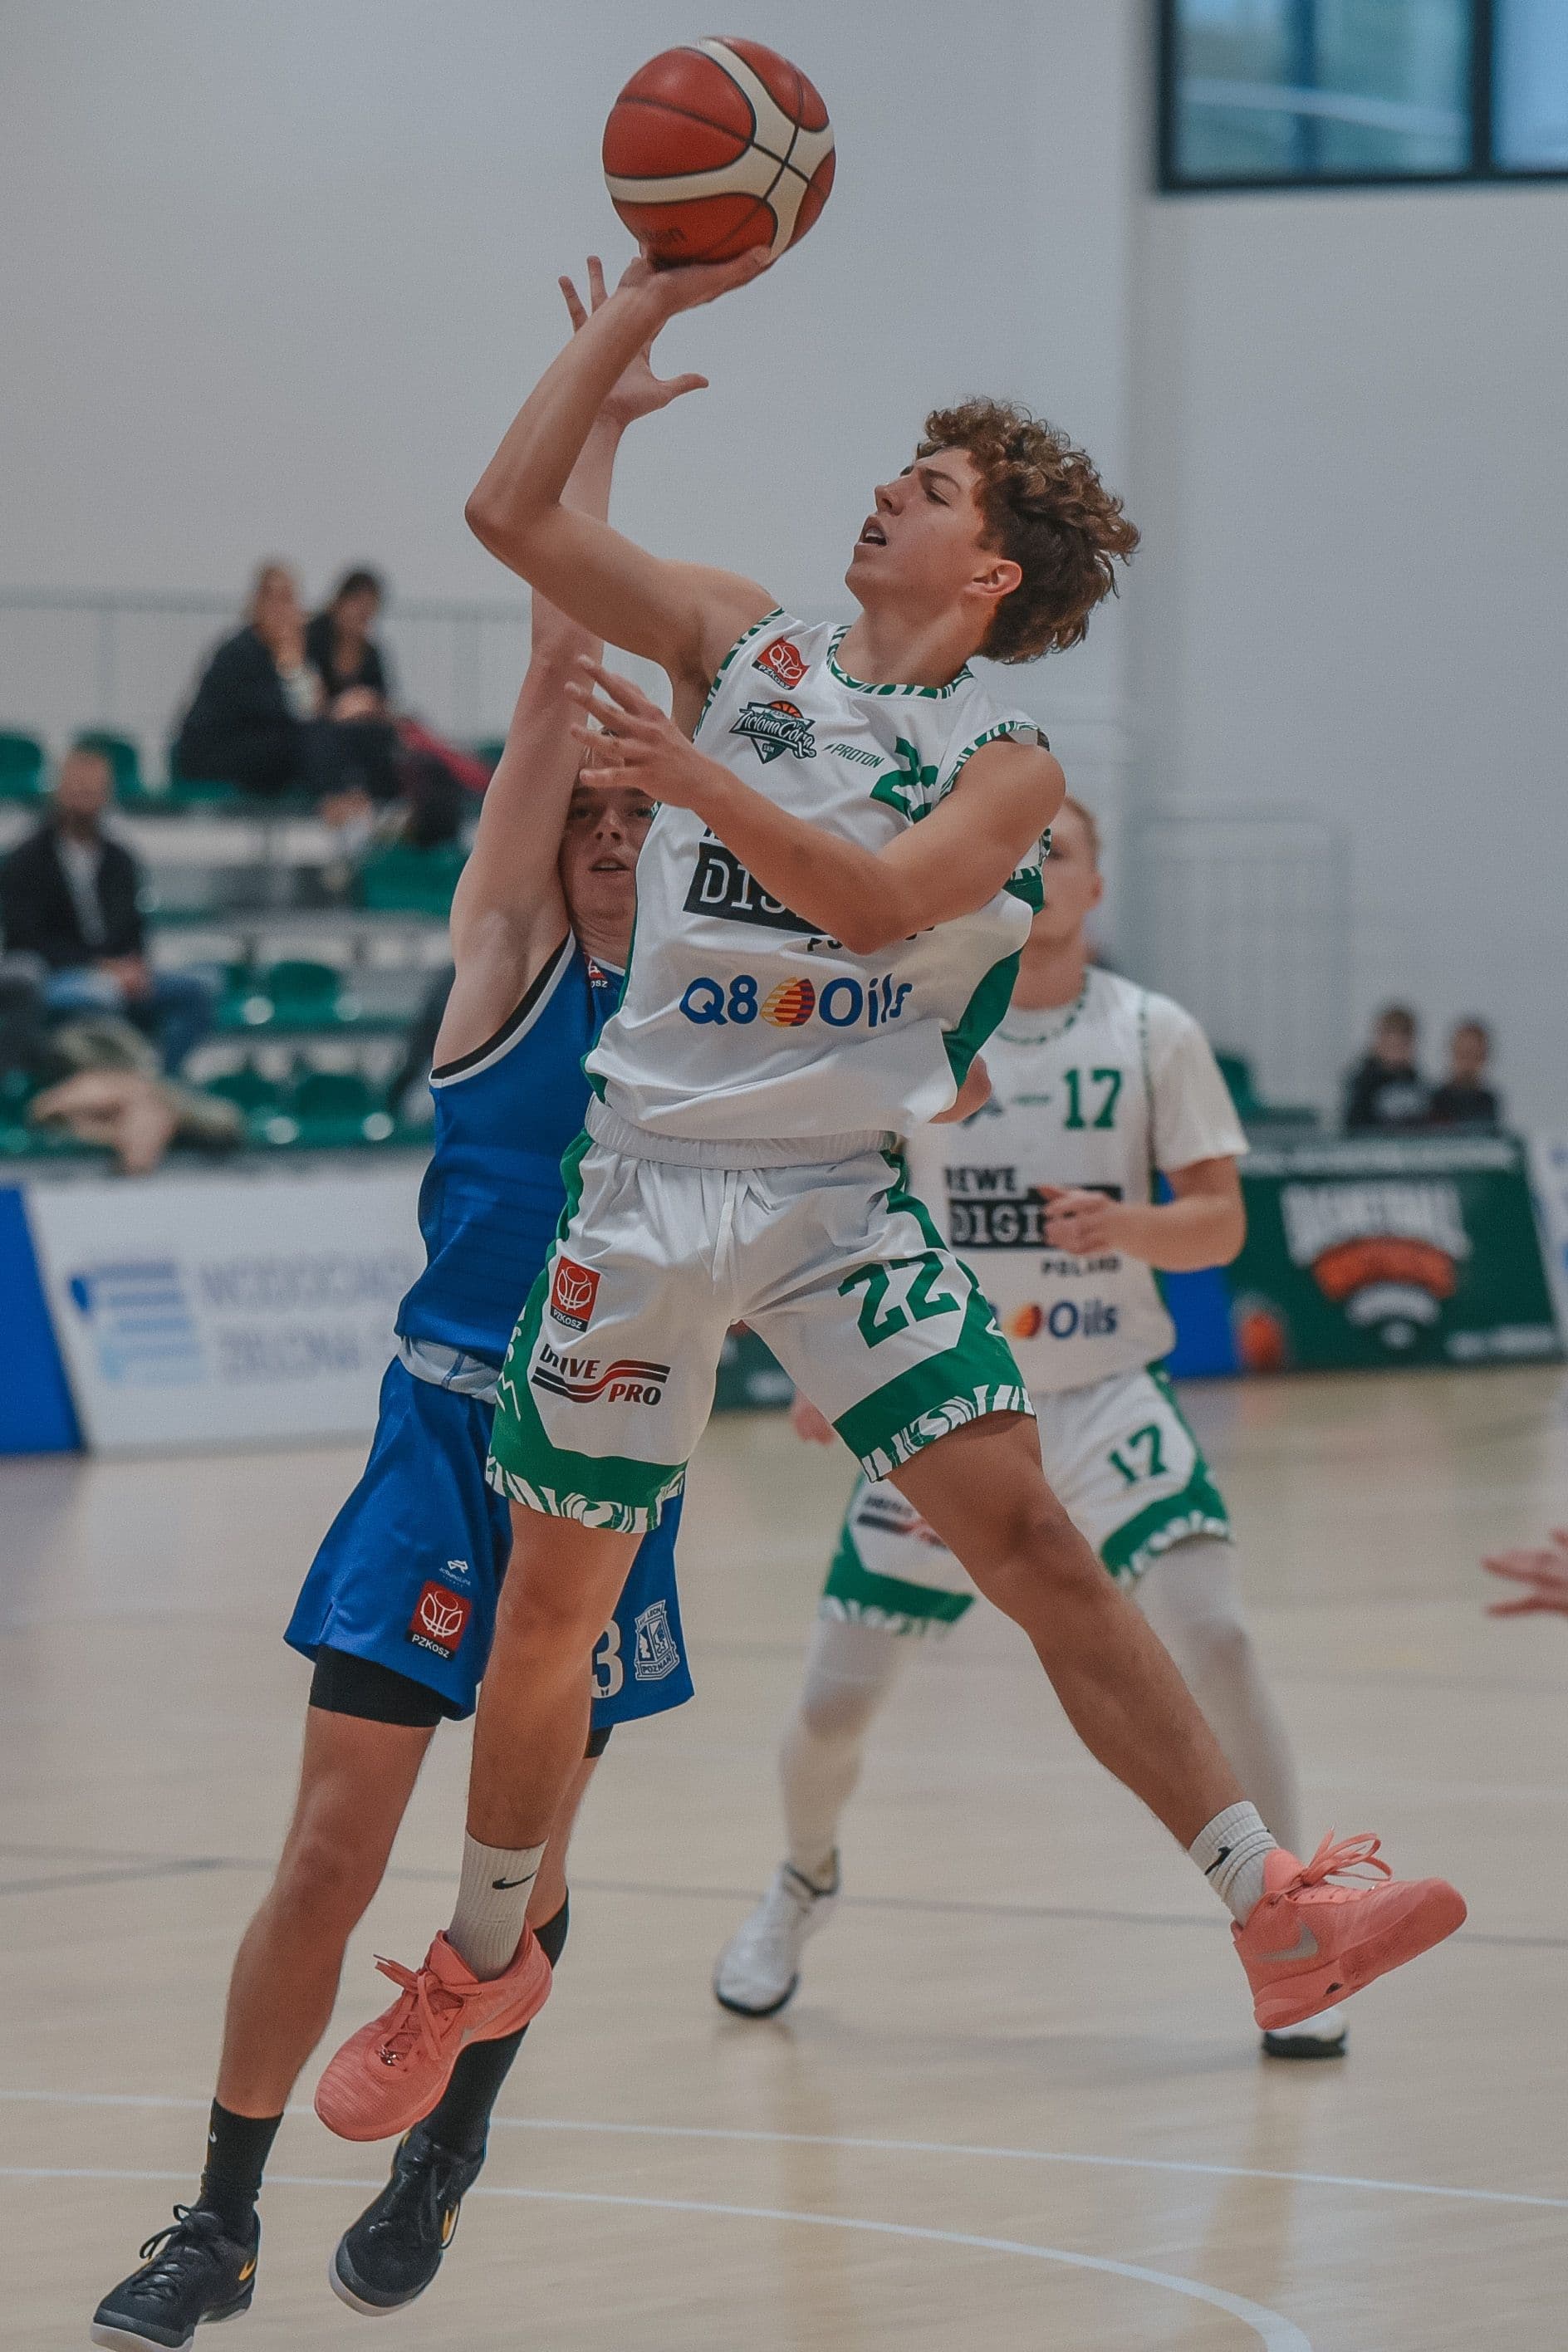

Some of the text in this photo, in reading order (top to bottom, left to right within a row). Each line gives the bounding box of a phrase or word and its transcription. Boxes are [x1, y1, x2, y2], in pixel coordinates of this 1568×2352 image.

[831, 743, 884, 768] PROTON
[679, 973, 913, 1027] Q8 Oils
[1063, 1067, 1122, 1129] 17
[553, 1308, 583, 1329] PZKOSZ
[837, 1252, 962, 1349] 22
[1048, 1301, 1118, 1340] Oils
[608, 1384, 662, 1406] PRO
[1109, 1423, 1167, 1483] 17
[412, 1634, 450, 1659] PZKOSZ
